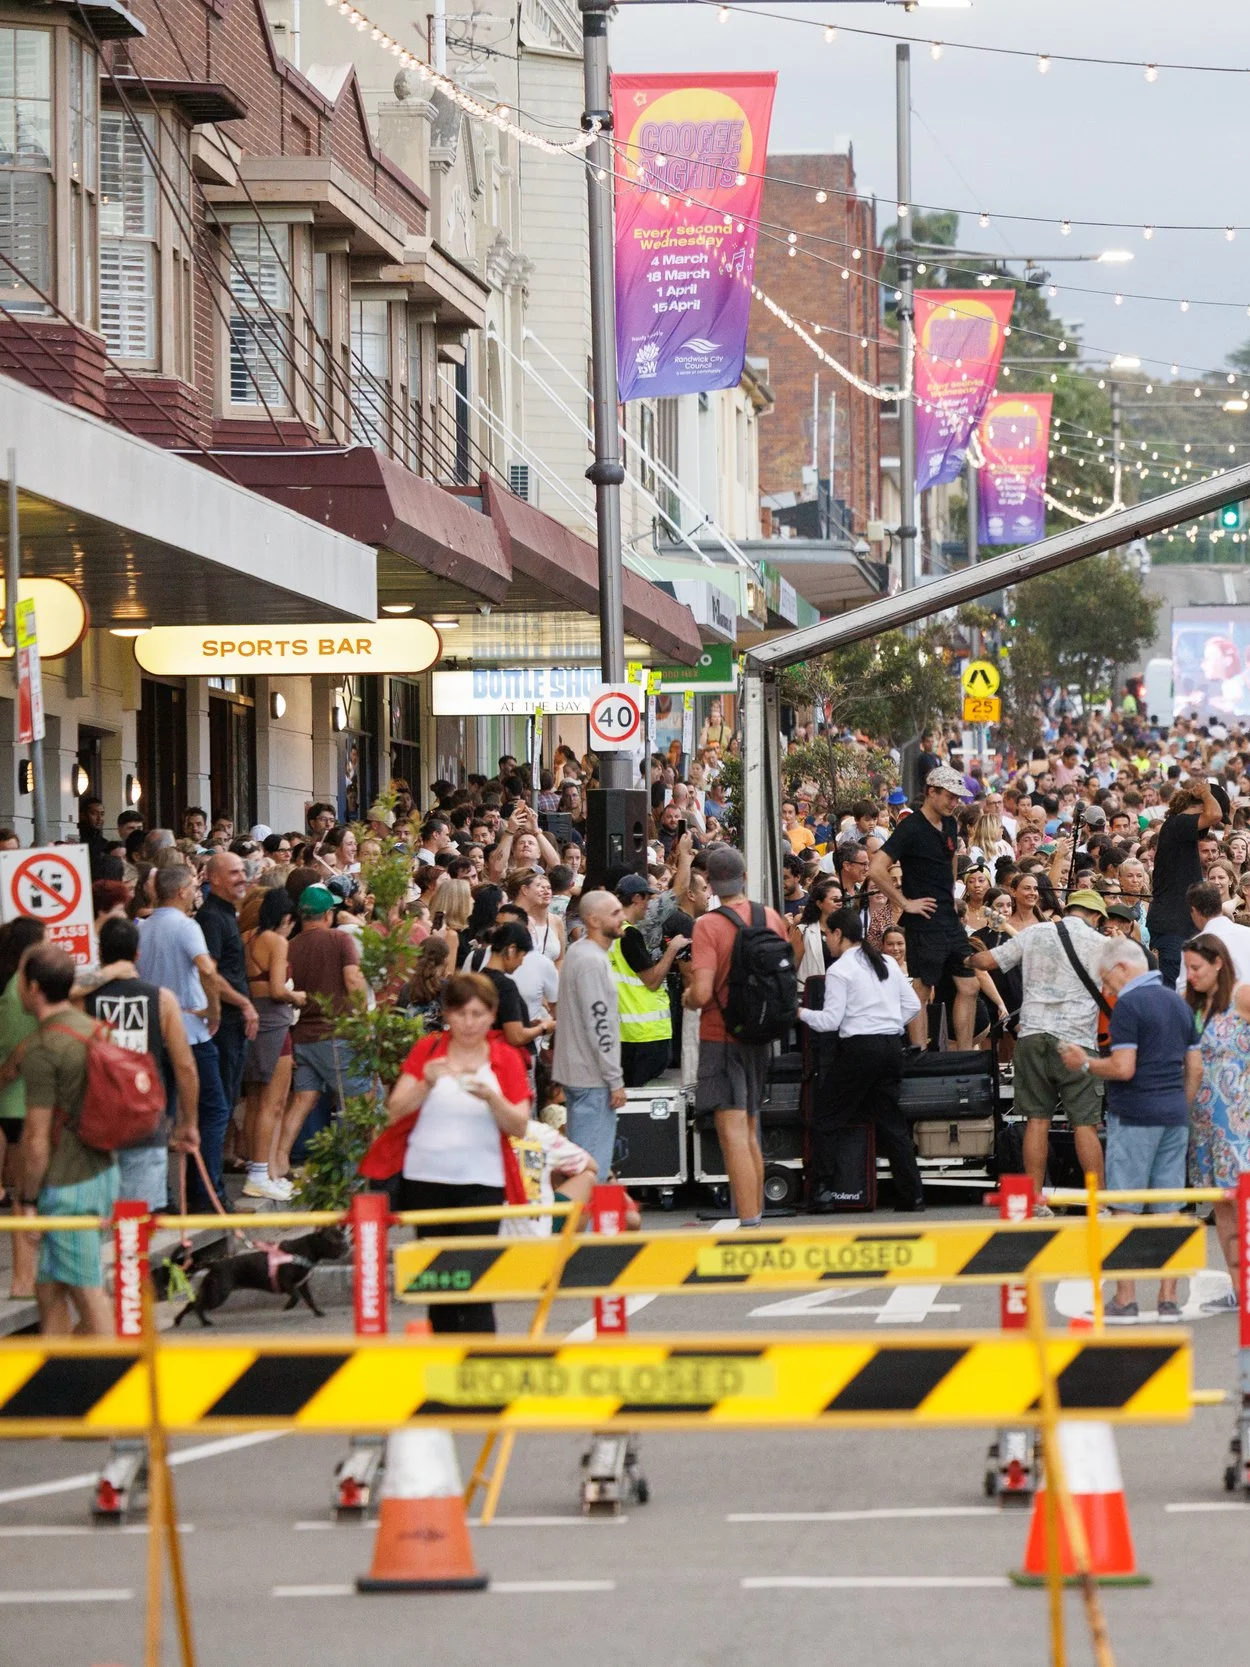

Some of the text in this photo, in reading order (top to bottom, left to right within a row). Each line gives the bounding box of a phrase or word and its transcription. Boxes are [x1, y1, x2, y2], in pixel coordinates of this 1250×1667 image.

[640, 120, 744, 157] COOGEE
[640, 155, 740, 192] NIGHTS
[633, 224, 733, 239] Every second
[640, 236, 724, 250] Wednesday
[651, 253, 709, 266] 4 March
[647, 269, 711, 282] 18 March
[657, 284, 698, 297] 1 April
[653, 300, 701, 313] 15 April
[710, 355, 724, 363] City
[202, 638, 372, 657] SPORTS BAR
[472, 669, 602, 699] BOTTLE SHO
[501, 702, 515, 712] AT
[524, 701, 550, 712] THE
[972, 700, 993, 713] 25
[597, 706, 633, 728] 40
[50, 925, 87, 937] LASS
[831, 1191, 861, 1200] Roland
[721, 1244, 913, 1273] ROAD CLOSED
[119, 1218, 142, 1335] PITAGONE
[360, 1221, 379, 1318] PITAGONE
[456, 1361, 744, 1397] ROAD CLOSED
